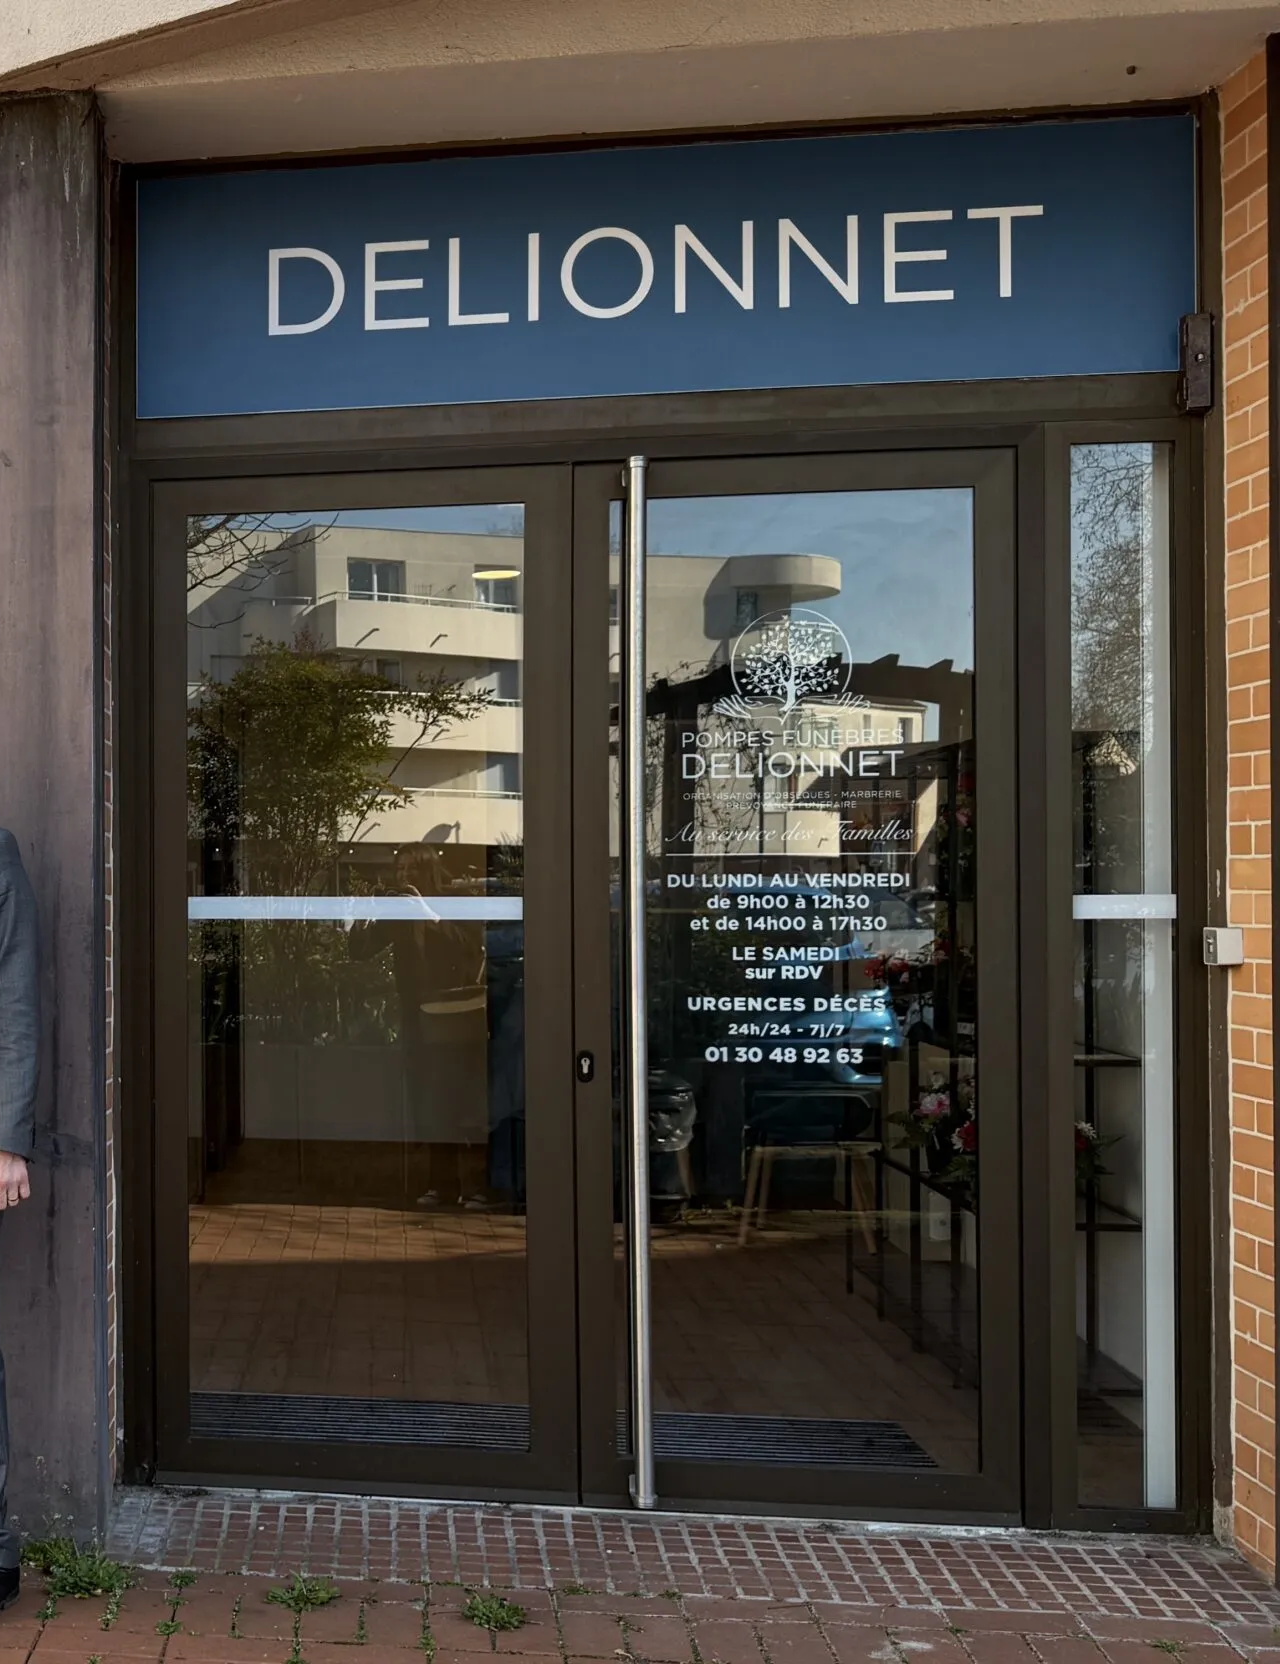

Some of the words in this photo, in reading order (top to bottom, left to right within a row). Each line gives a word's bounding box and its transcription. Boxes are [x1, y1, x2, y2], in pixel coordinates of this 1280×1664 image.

[267, 204, 1044, 336] DELIONNET
[682, 731, 774, 748] POMPES
[682, 750, 905, 779] DELIONNET
[682, 790, 761, 802] ORGANISATION
[841, 789, 903, 799] MARBRERIE
[665, 821, 705, 842] Au
[706, 826, 778, 841] service
[780, 819, 815, 842] des
[668, 874, 695, 888] DU
[701, 874, 763, 888] LUNDI
[770, 873, 799, 888] AU
[804, 873, 911, 888] VENDREDI
[706, 895, 732, 910] de
[737, 895, 789, 910] 9h00
[794, 894, 807, 910] à
[813, 895, 870, 910] 12h30
[689, 917, 710, 931] et
[715, 916, 740, 931] de
[745, 916, 807, 931] 14h00
[812, 916, 824, 931] à
[828, 916, 888, 931] 17h30
[731, 947, 757, 961] LE
[762, 946, 840, 961] SAMEDI
[745, 968, 777, 980] sur
[780, 966, 824, 980] RDV
[687, 997, 807, 1012] URGENCES
[813, 994, 887, 1012] DÉCÈS
[727, 1022, 792, 1037] 24h/24
[809, 1023, 845, 1038] 7j/7
[704, 1047, 729, 1063] 01
[734, 1047, 763, 1063] 30
[768, 1048, 797, 1063] 48
[803, 1048, 832, 1064] 92
[835, 1048, 864, 1064] 63
